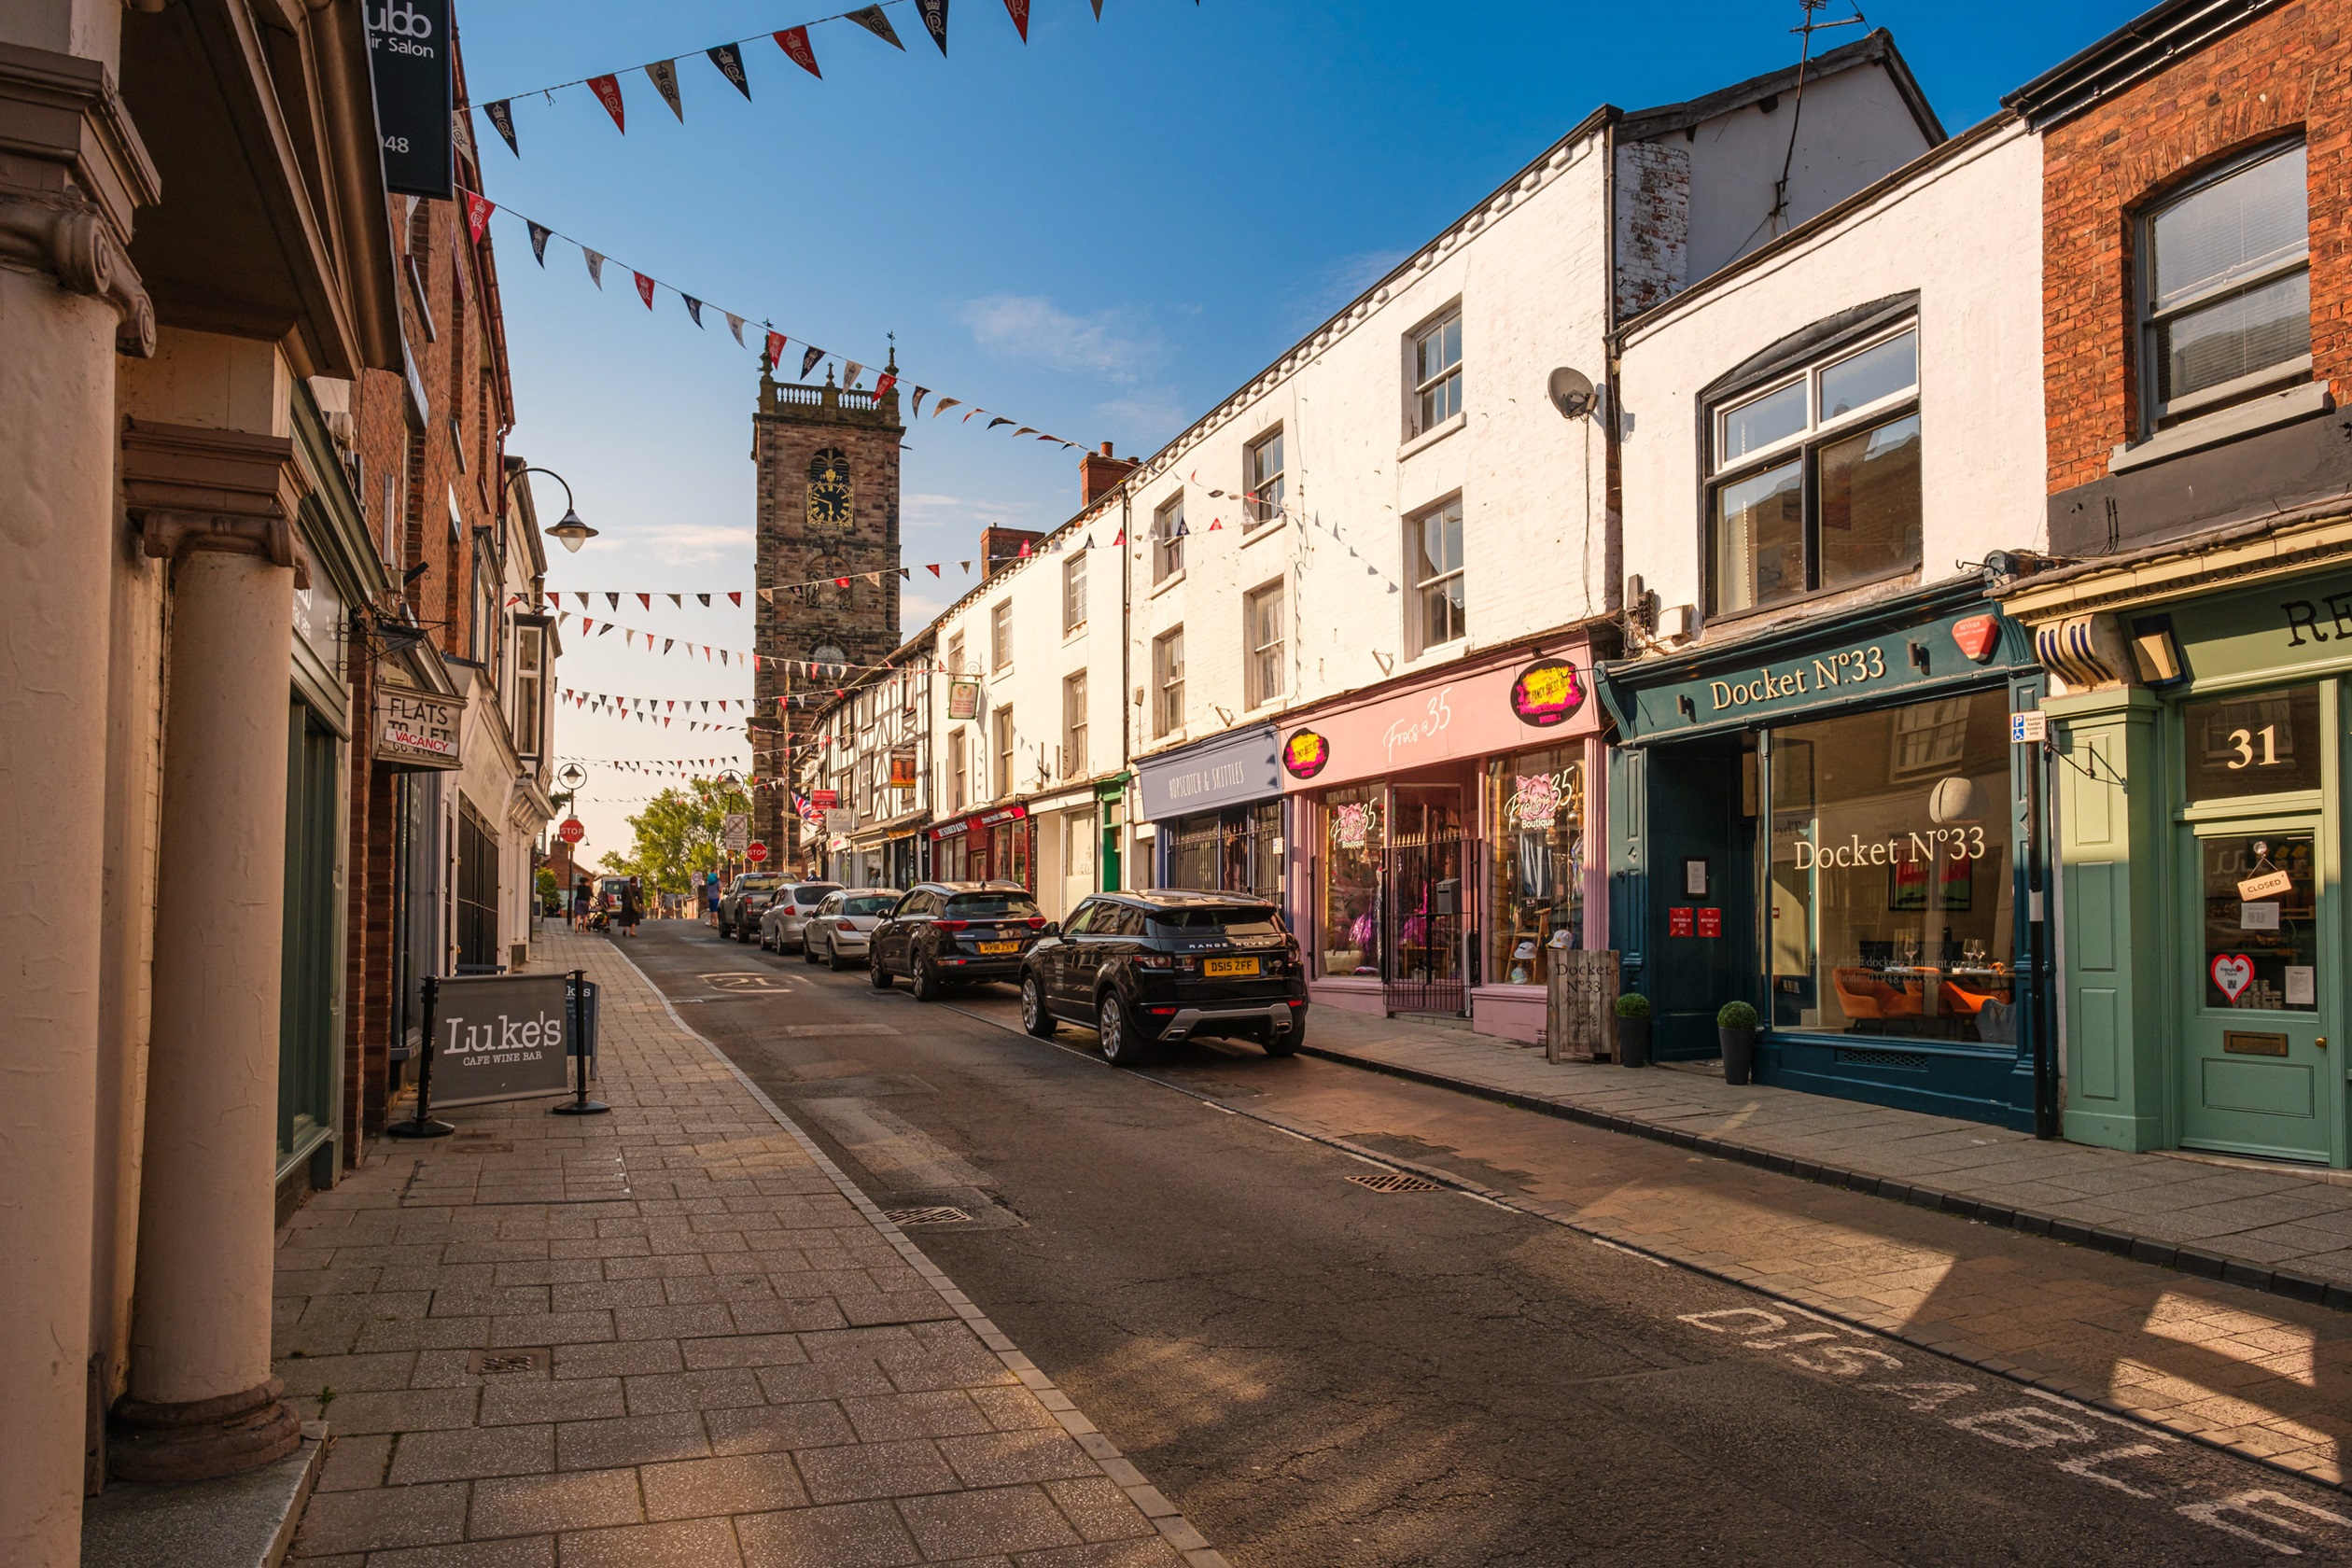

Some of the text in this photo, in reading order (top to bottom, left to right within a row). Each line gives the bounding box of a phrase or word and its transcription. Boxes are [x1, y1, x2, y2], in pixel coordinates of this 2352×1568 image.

[366, 0, 432, 39] ubb
[388, 37, 434, 59] Salon
[1709, 668, 1809, 710] Docket
[390, 697, 448, 725] FLATS
[395, 731, 449, 752] VACANCY
[2227, 724, 2281, 769] 31
[1169, 761, 1244, 800] HOPSCOTCH & SKITTLES
[561, 827, 583, 835] STOP
[1521, 818, 1556, 830] Boutique
[1794, 834, 1898, 870] Docket
[2247, 879, 2281, 893] CLOSED
[1211, 960, 1253, 973] DS15 ZFF
[1556, 962, 1611, 976] Docket
[443, 1011, 561, 1055] Luke's
[463, 1051, 543, 1067] CAFE WINE BAR
